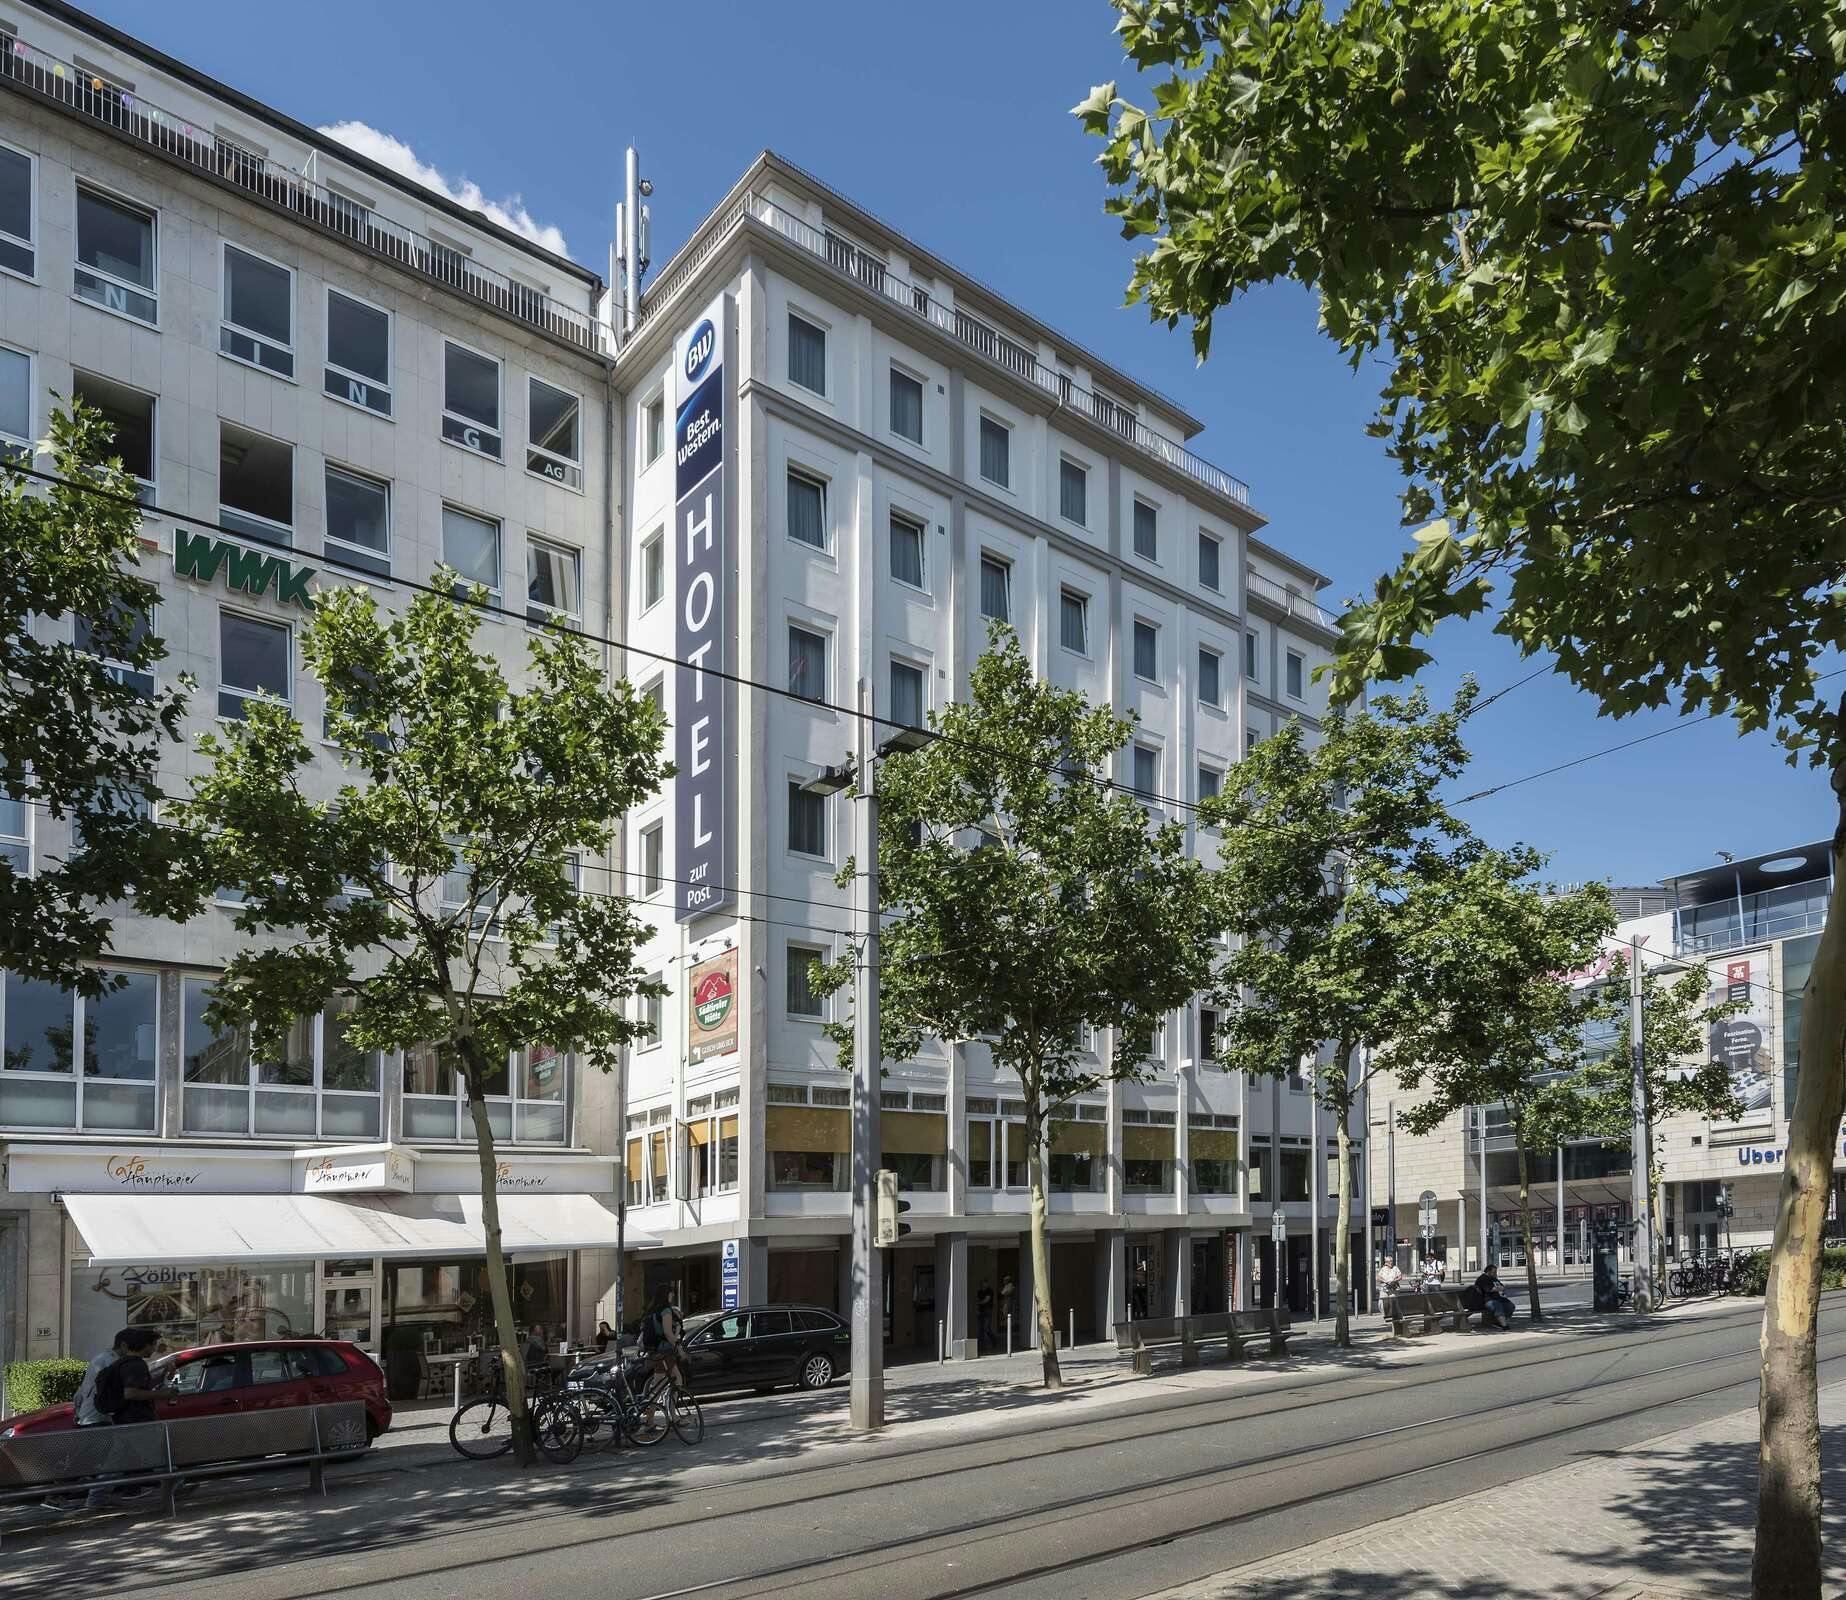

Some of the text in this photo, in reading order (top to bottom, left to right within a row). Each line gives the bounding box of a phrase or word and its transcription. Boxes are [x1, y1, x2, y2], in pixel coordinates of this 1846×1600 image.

[688, 328, 713, 374] BW
[687, 409, 710, 442] Best
[544, 463, 564, 481] AG
[173, 528, 317, 610] WWK
[685, 493, 714, 850] HOTEL
[689, 861, 709, 883] zur
[687, 884, 712, 908] Post
[699, 999, 728, 1017] Südtiroler
[704, 1011, 721, 1024] Hütte
